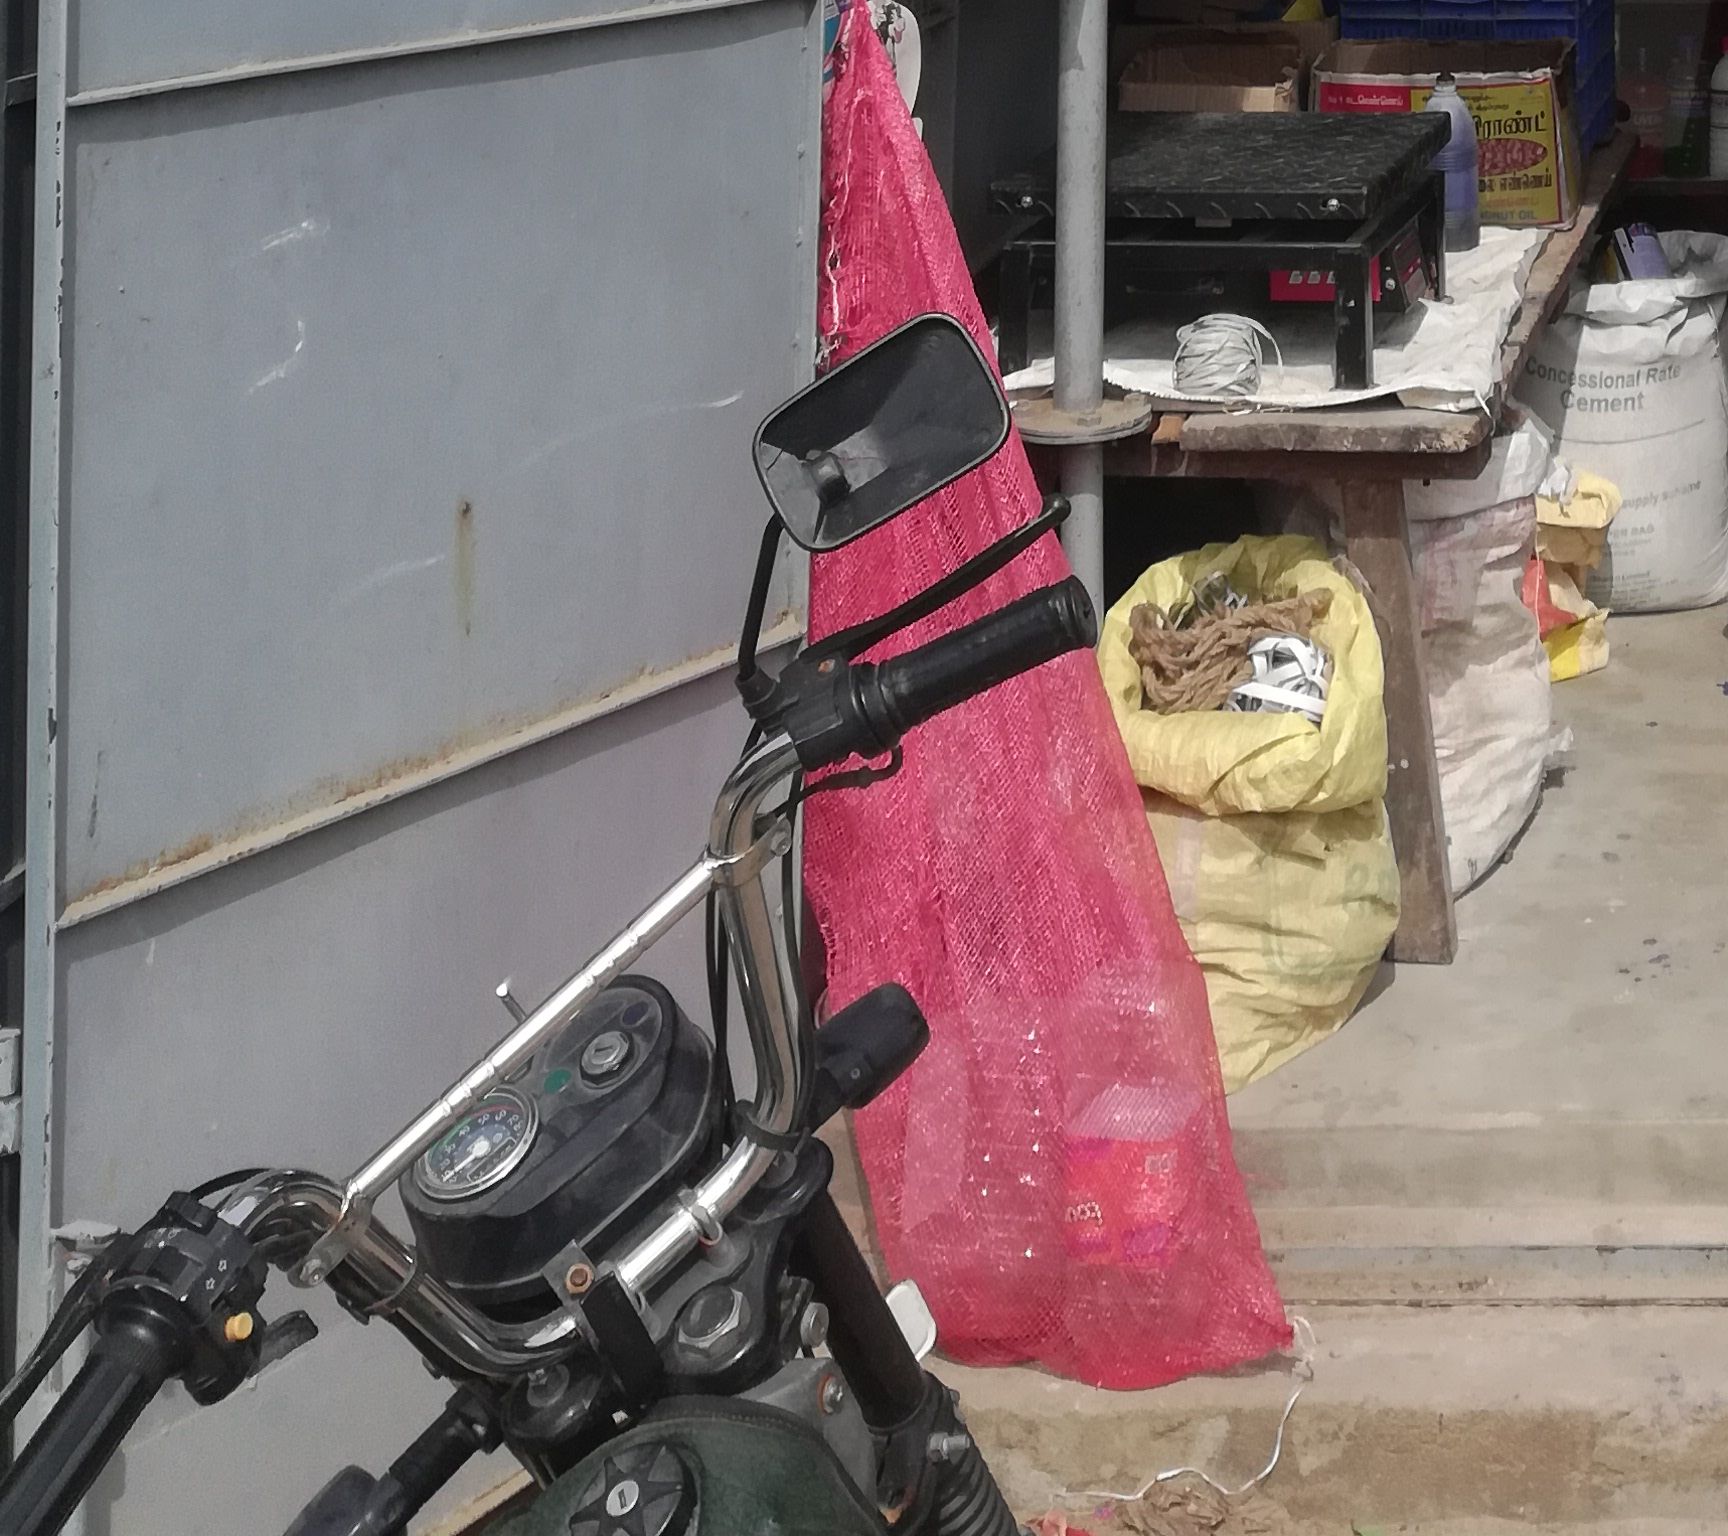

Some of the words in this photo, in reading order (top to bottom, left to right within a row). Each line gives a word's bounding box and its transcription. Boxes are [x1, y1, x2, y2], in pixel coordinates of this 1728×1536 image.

[1525, 355, 1641, 389] Concessional
[1645, 364, 1681, 385] Rate
[1560, 389, 1645, 413] Cement
[494, 1109, 507, 1121] 60
[507, 1114, 519, 1125] 70
